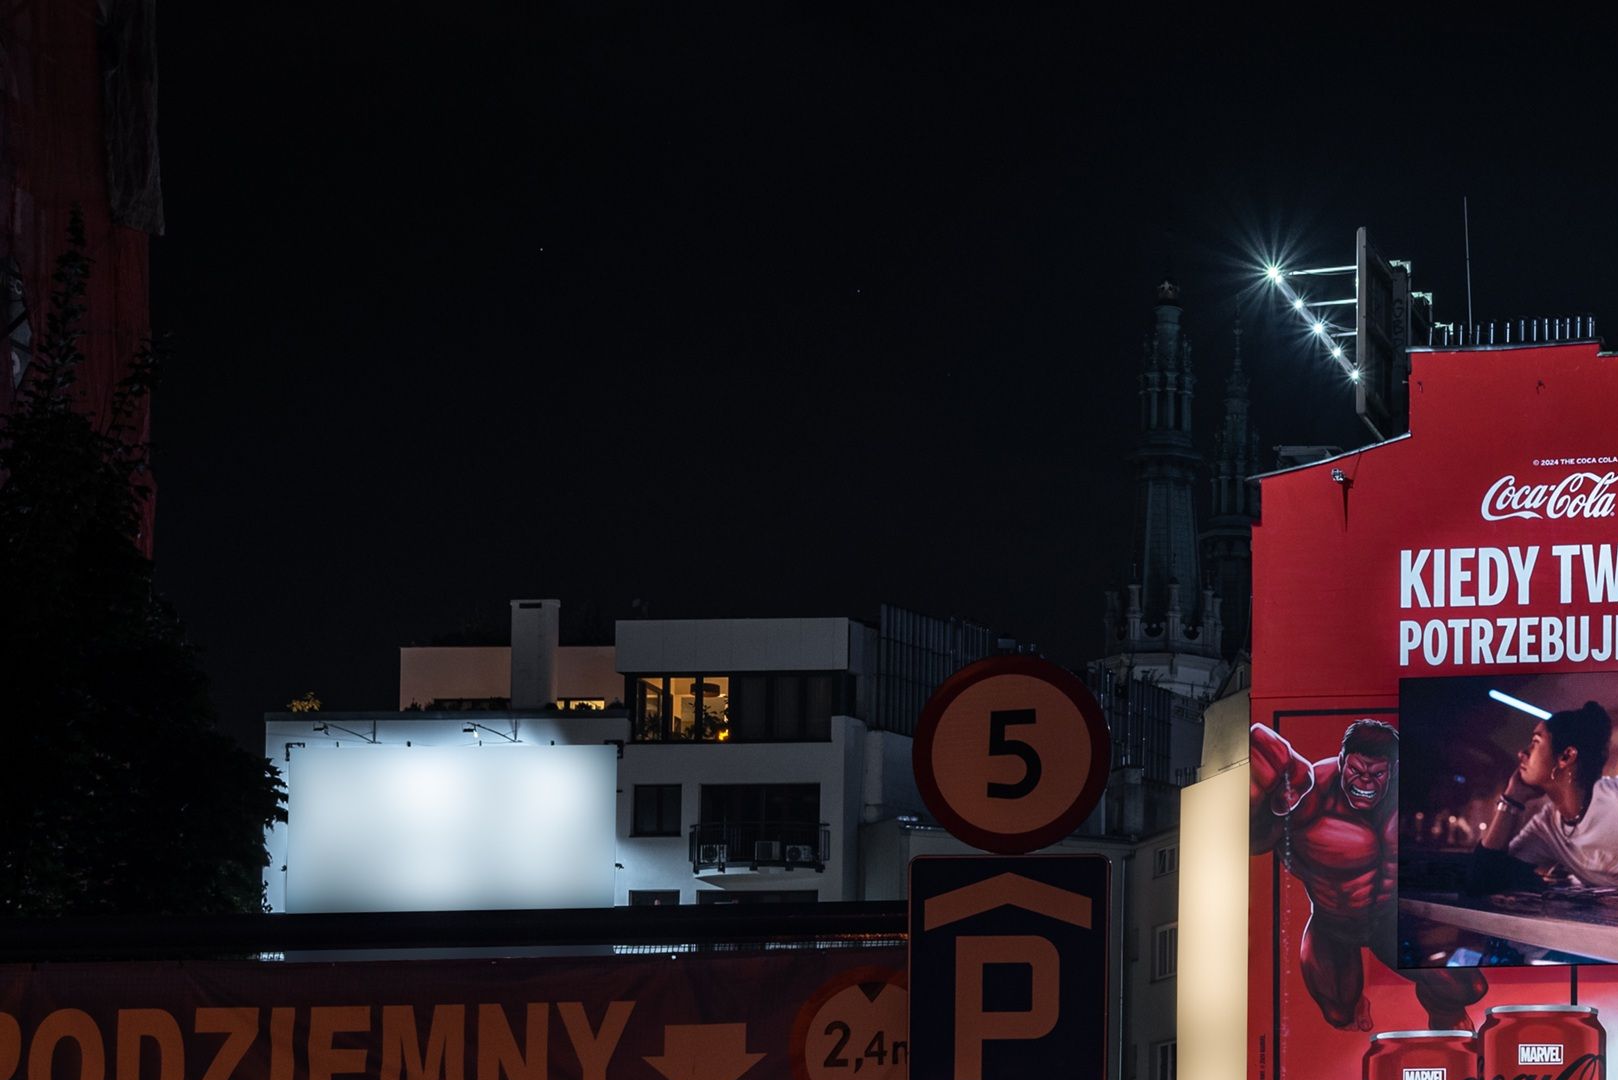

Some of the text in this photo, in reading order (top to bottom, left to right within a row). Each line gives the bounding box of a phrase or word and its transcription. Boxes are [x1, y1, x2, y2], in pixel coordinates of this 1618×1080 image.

[1541, 458, 1559, 466] 2024
[1560, 457, 1575, 465] THE
[1576, 456, 1597, 465] COCA
[1598, 455, 1618, 464] COLA
[1400, 545, 1540, 608] KIEDY
[987, 708, 1042, 799] 5
[1520, 1046, 1561, 1063] MARVEL
